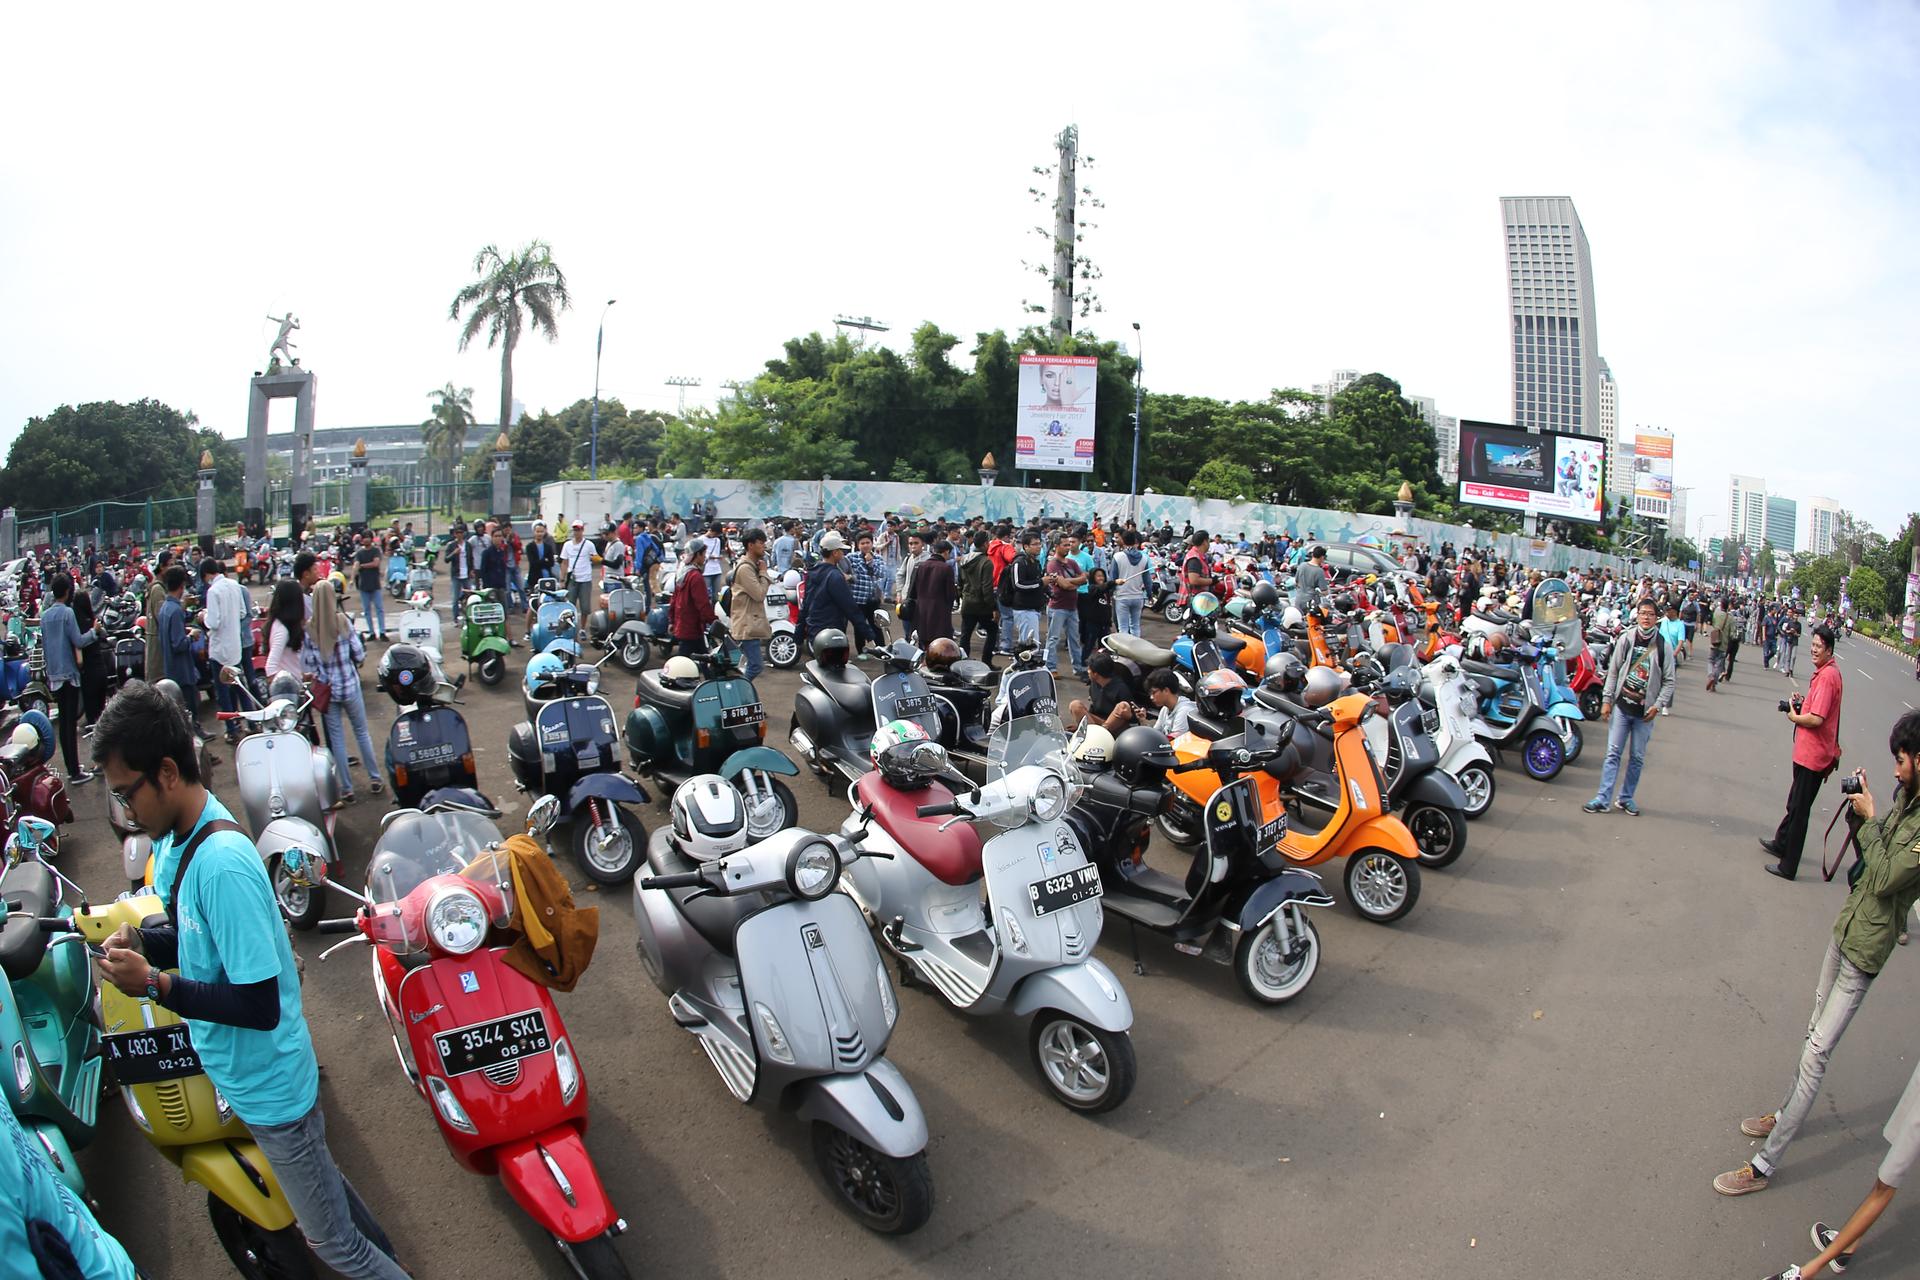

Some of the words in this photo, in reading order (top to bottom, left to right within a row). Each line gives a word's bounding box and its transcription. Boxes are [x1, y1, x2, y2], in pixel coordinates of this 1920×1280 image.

[1030, 885, 1040, 901] B
[1045, 874, 1074, 895] 6329
[1077, 866, 1098, 884] VNU
[111, 1041, 122, 1058] A
[128, 1037, 158, 1056] 4823
[167, 1032, 188, 1051] ZK
[438, 1039, 452, 1057] B
[461, 1024, 504, 1050] 3544
[510, 1015, 544, 1038] SKL
